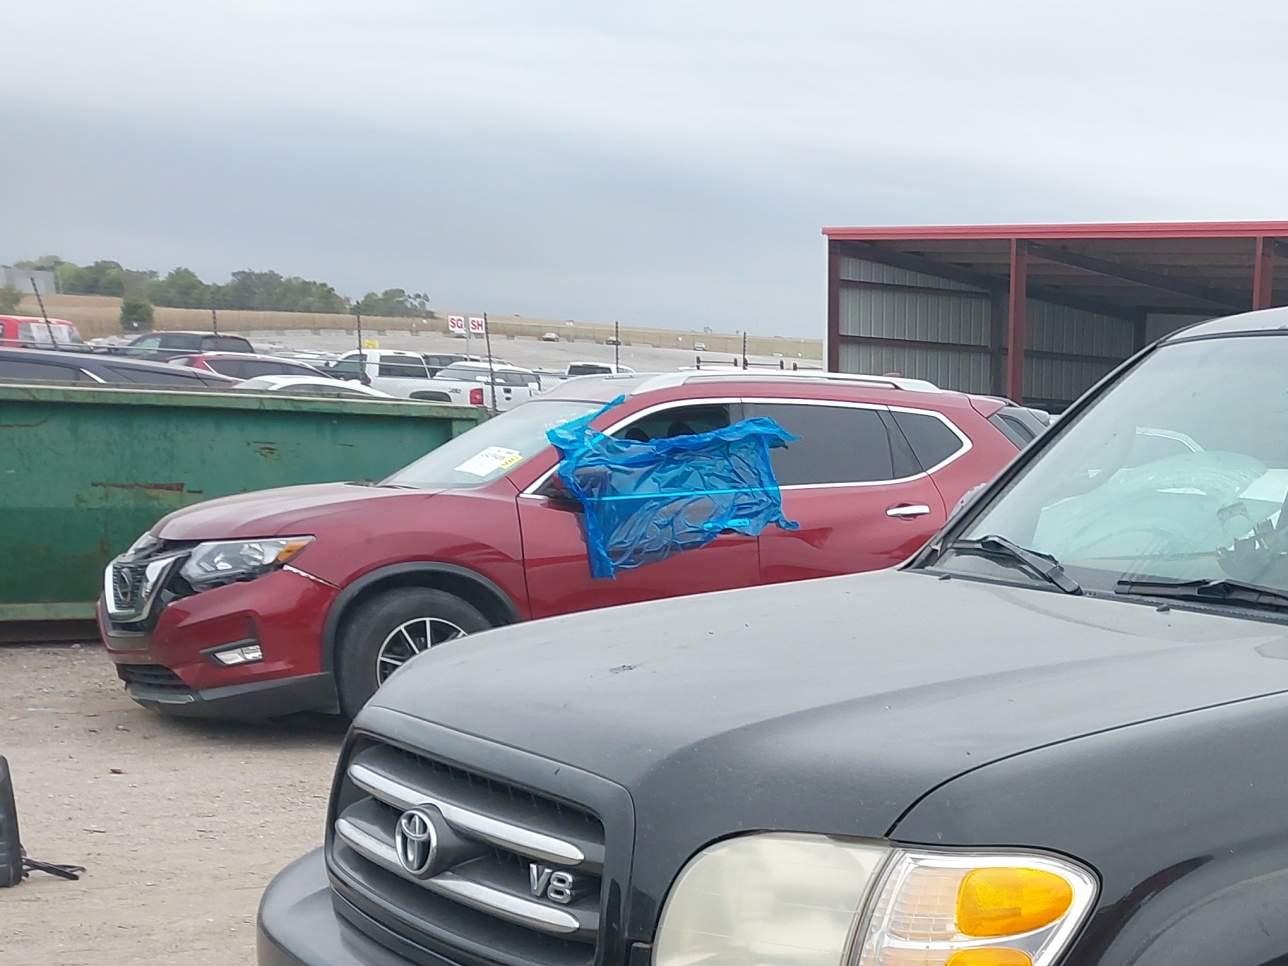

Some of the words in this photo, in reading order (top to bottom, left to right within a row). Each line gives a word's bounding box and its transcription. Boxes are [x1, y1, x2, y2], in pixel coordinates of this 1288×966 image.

[449, 317, 464, 329] SG
[470, 319, 483, 331] SH
[529, 863, 573, 904] V8
